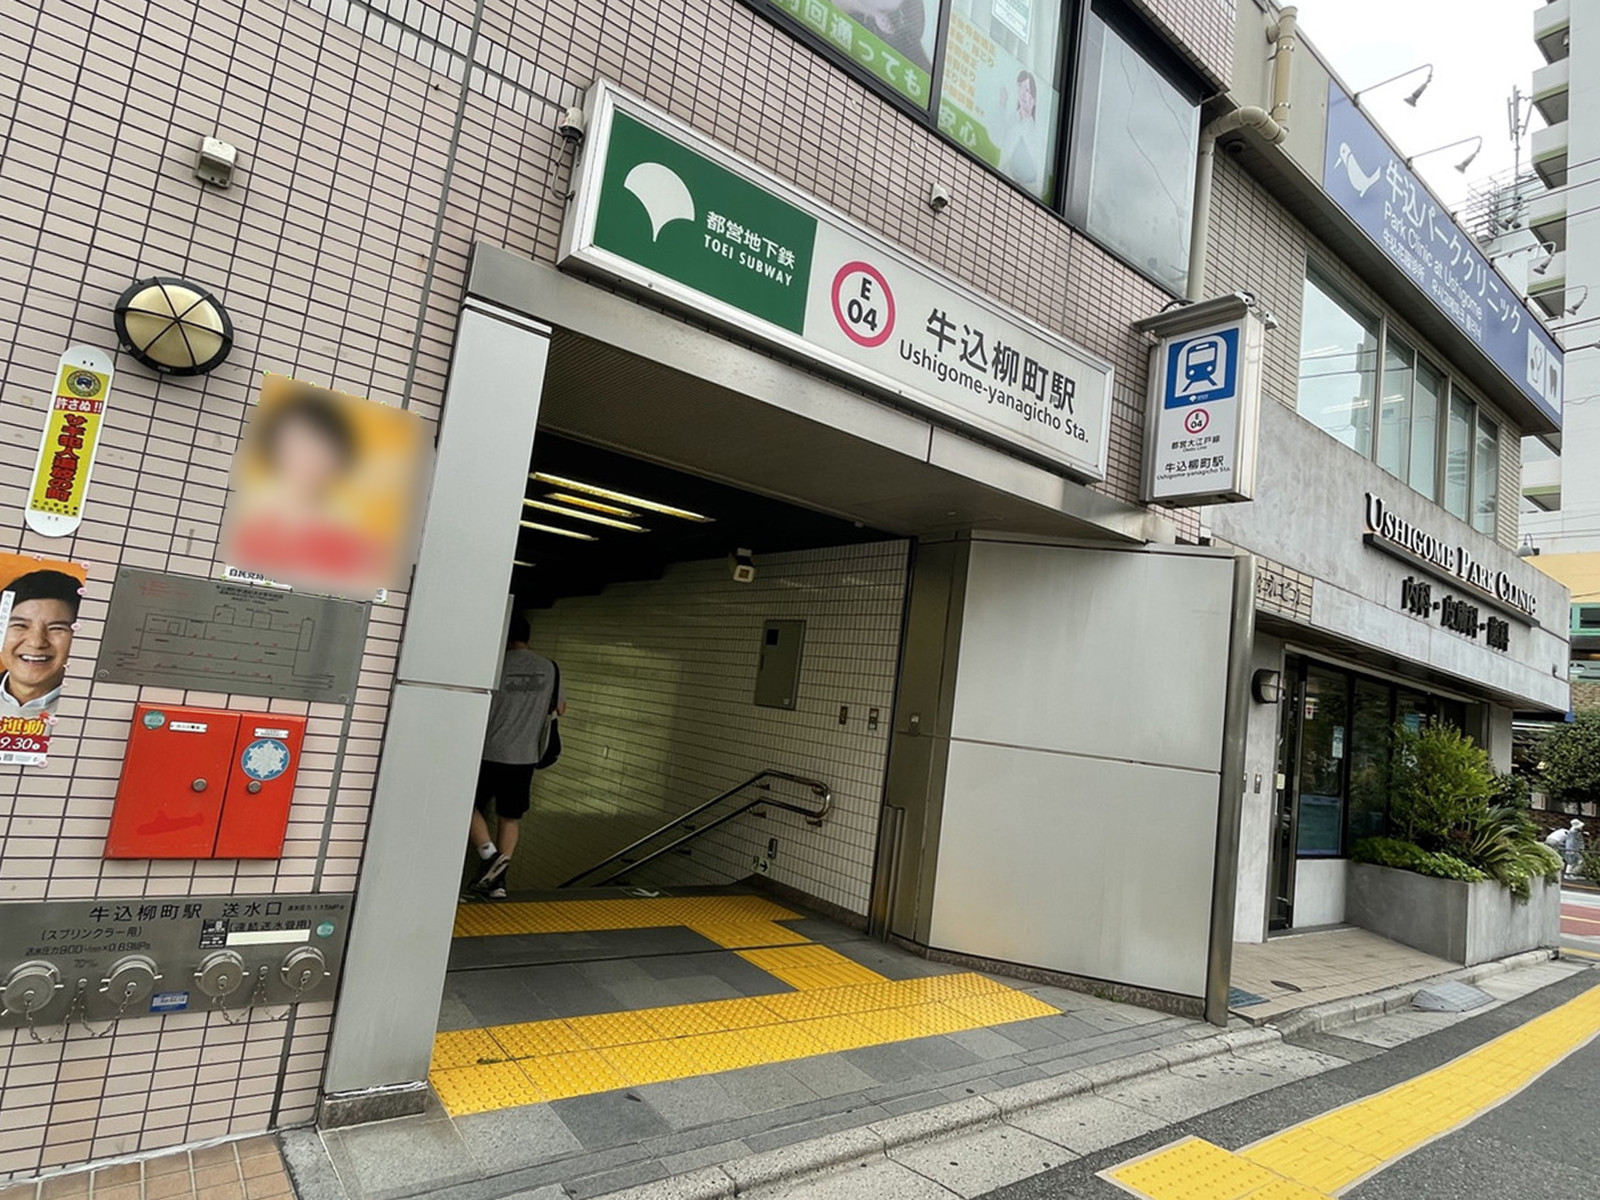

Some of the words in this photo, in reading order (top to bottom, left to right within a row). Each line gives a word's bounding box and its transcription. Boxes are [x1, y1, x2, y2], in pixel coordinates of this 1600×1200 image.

[705, 210, 796, 271] 都営地下鉄
[1385, 158, 1522, 334] 牛込パーククリニック
[703, 233, 734, 262] TOEI
[739, 246, 794, 288] SUBWAY
[1385, 203, 1406, 240] Park
[1407, 226, 1432, 270] Clinic
[1433, 260, 1444, 281] at
[1444, 267, 1483, 318] Ushigome
[860, 278, 873, 302] E
[848, 299, 878, 332] 04
[926, 308, 1077, 416] 牛込柳町駅
[899, 339, 1061, 431] Ushigome-yanagicho
[1065, 416, 1090, 445] Sta.
[1190, 420, 1203, 429] 04
[1194, 412, 1200, 421] E
[1171, 435, 1221, 451] 都営大江戸線
[1165, 456, 1225, 473] 牛込柳町駅
[1366, 493, 1455, 573] USHIGOME
[1457, 547, 1498, 595] PARK
[1496, 571, 1537, 615] CLINIC
[89, 903, 203, 921] 牛込柳町駅
[221, 901, 282, 918] 送水口
[41, 926, 144, 942] (スプリンクラー用)
